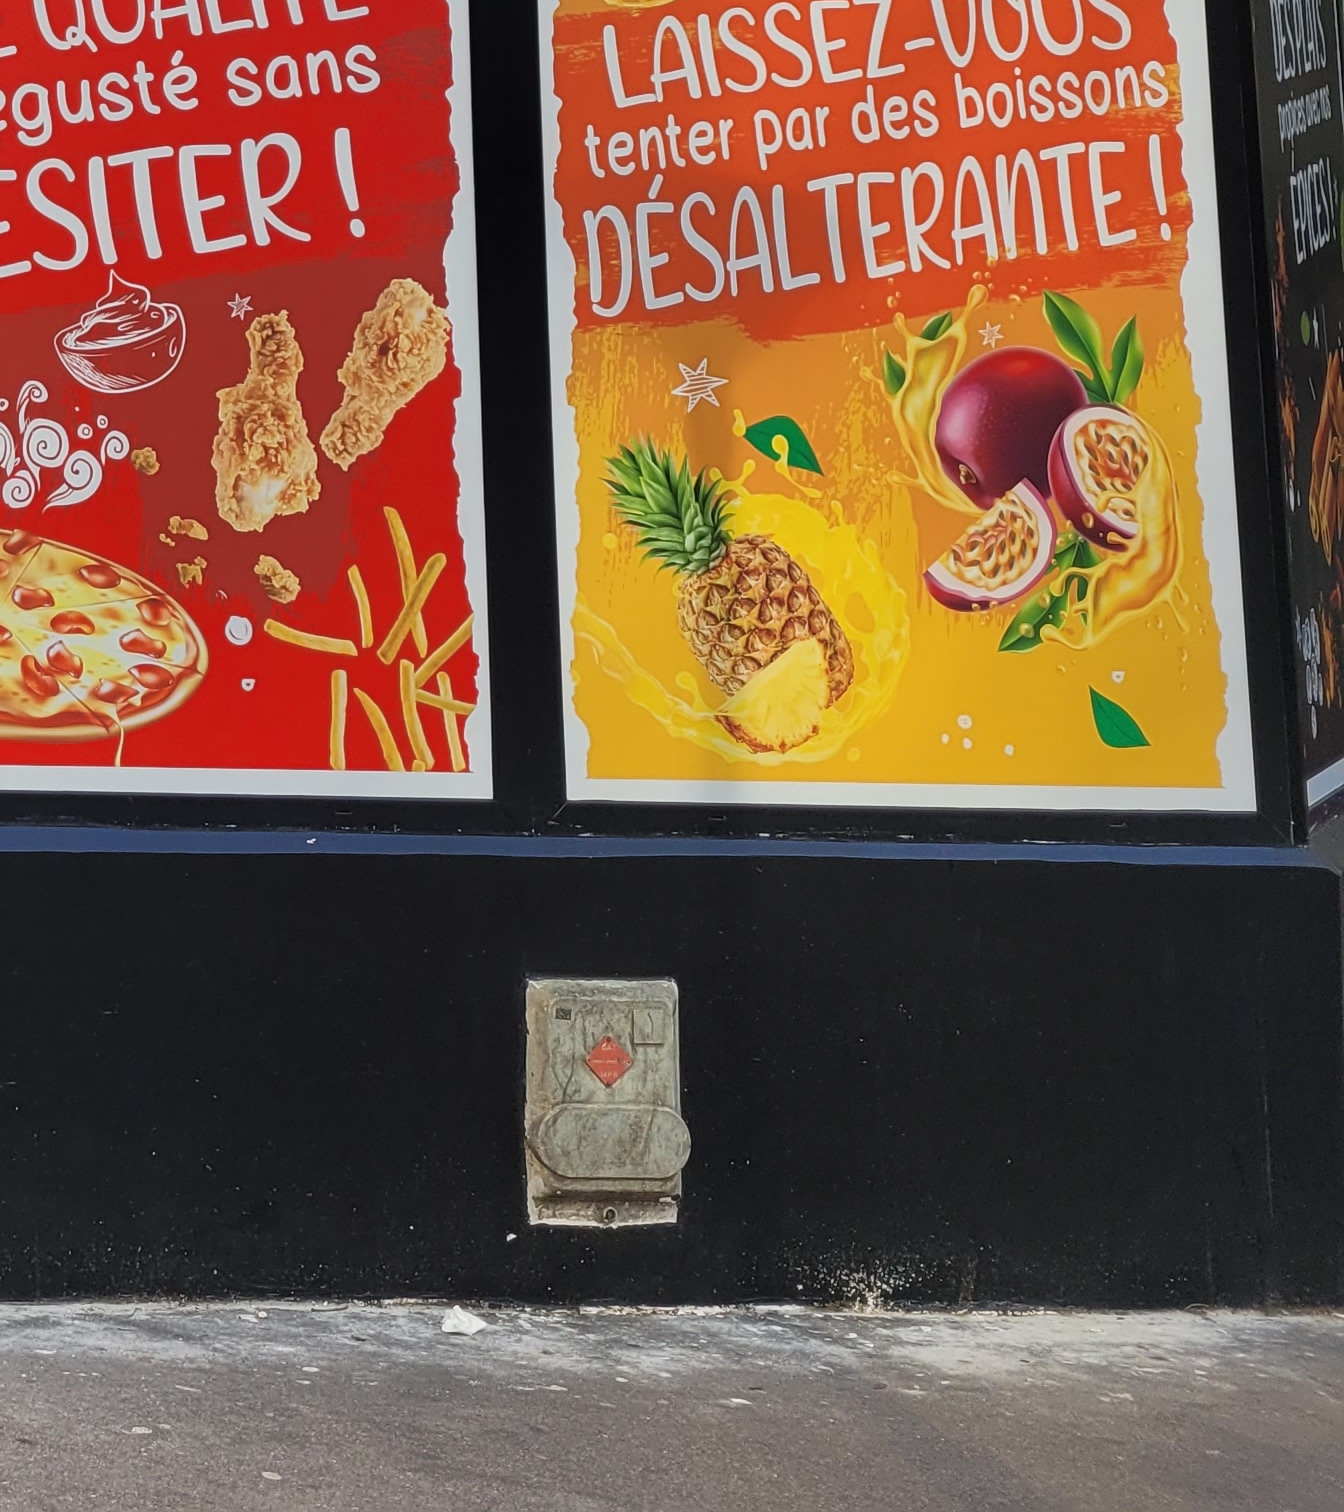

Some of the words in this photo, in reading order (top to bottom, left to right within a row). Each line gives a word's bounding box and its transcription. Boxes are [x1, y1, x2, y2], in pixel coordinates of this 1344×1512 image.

[227, 45, 380, 106] sans
[585, 114, 733, 177] tenter
[754, 107, 829, 170] par
[852, 85, 938, 143] des
[955, 61, 1168, 128] boissons
[583, 142, 1136, 317] DÉSALTERANTE
